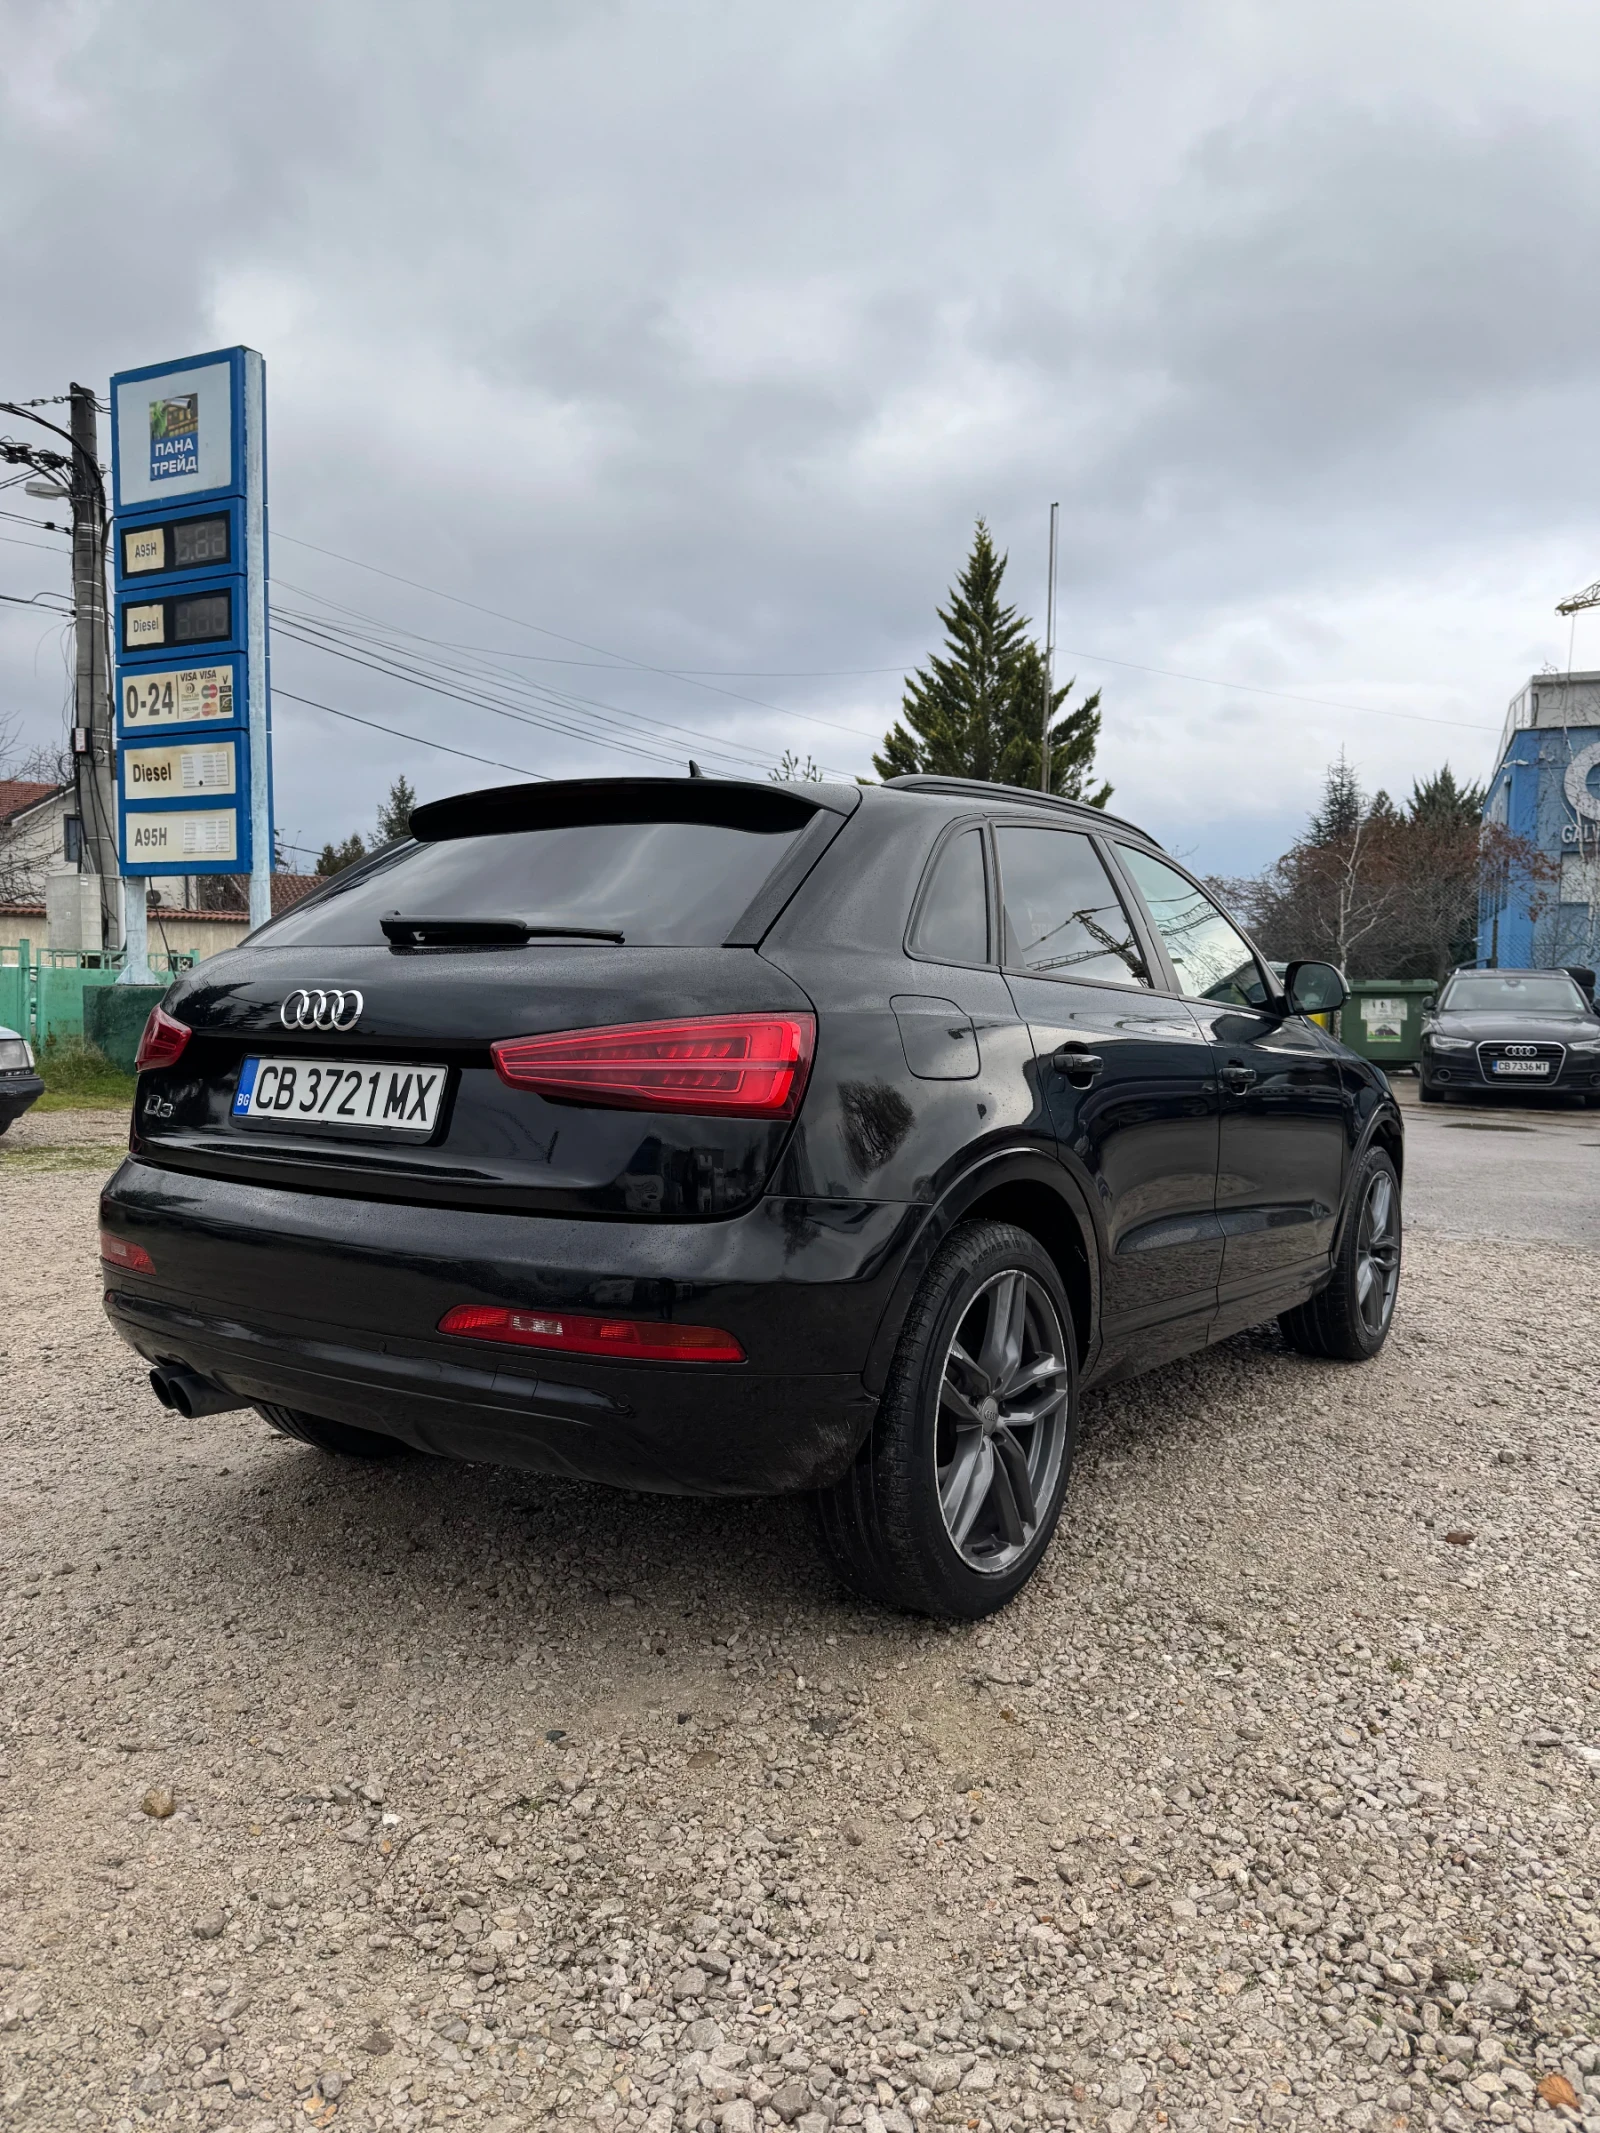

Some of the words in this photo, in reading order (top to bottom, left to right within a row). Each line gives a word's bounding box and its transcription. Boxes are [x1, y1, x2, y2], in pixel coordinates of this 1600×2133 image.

[155, 438, 194, 456] ПАНА
[152, 454, 197, 476] ТРЕЙД
[133, 617, 159, 632] Diesel
[180, 672, 198, 682] VISA
[200, 669, 217, 680] VISA
[126, 681, 174, 719] 0-24
[133, 763, 172, 783] Diesel
[1512, 1062, 1534, 1071] 7336
[237, 1093, 250, 1107] BG
[299, 1068, 379, 1118] 3721
[144, 1095, 173, 1117] Q3
